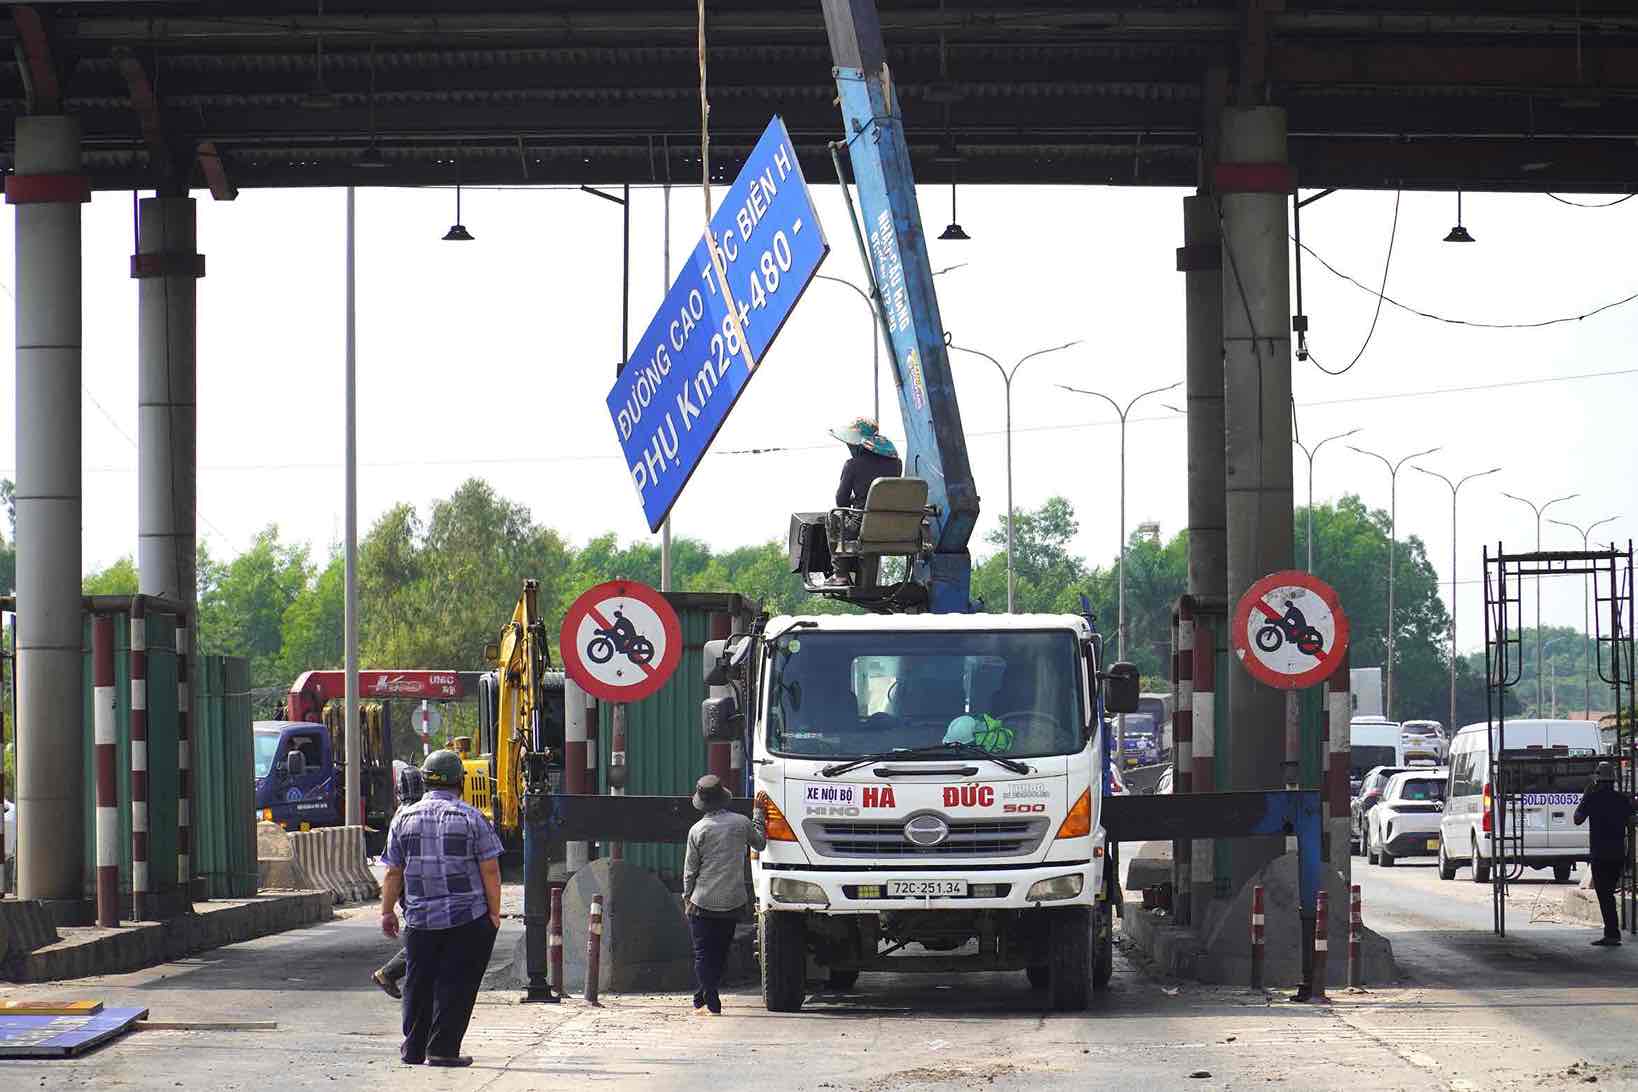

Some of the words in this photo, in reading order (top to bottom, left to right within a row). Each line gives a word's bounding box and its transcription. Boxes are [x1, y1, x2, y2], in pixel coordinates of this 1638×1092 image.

[617, 344, 671, 440] ĐƯỜNG
[670, 289, 703, 352] CAO
[736, 167, 777, 242] BIÊN
[773, 144, 792, 181] H
[632, 413, 681, 506] PHỤ
[807, 787, 819, 800] XE
[821, 786, 838, 803] NỘI
[840, 786, 853, 804] BỘ
[863, 783, 896, 808] HÀ
[943, 783, 994, 808] ĐỨC
[806, 806, 860, 816] HINO
[1003, 804, 1046, 813] 500
[894, 882, 960, 894] 72C-251.34
